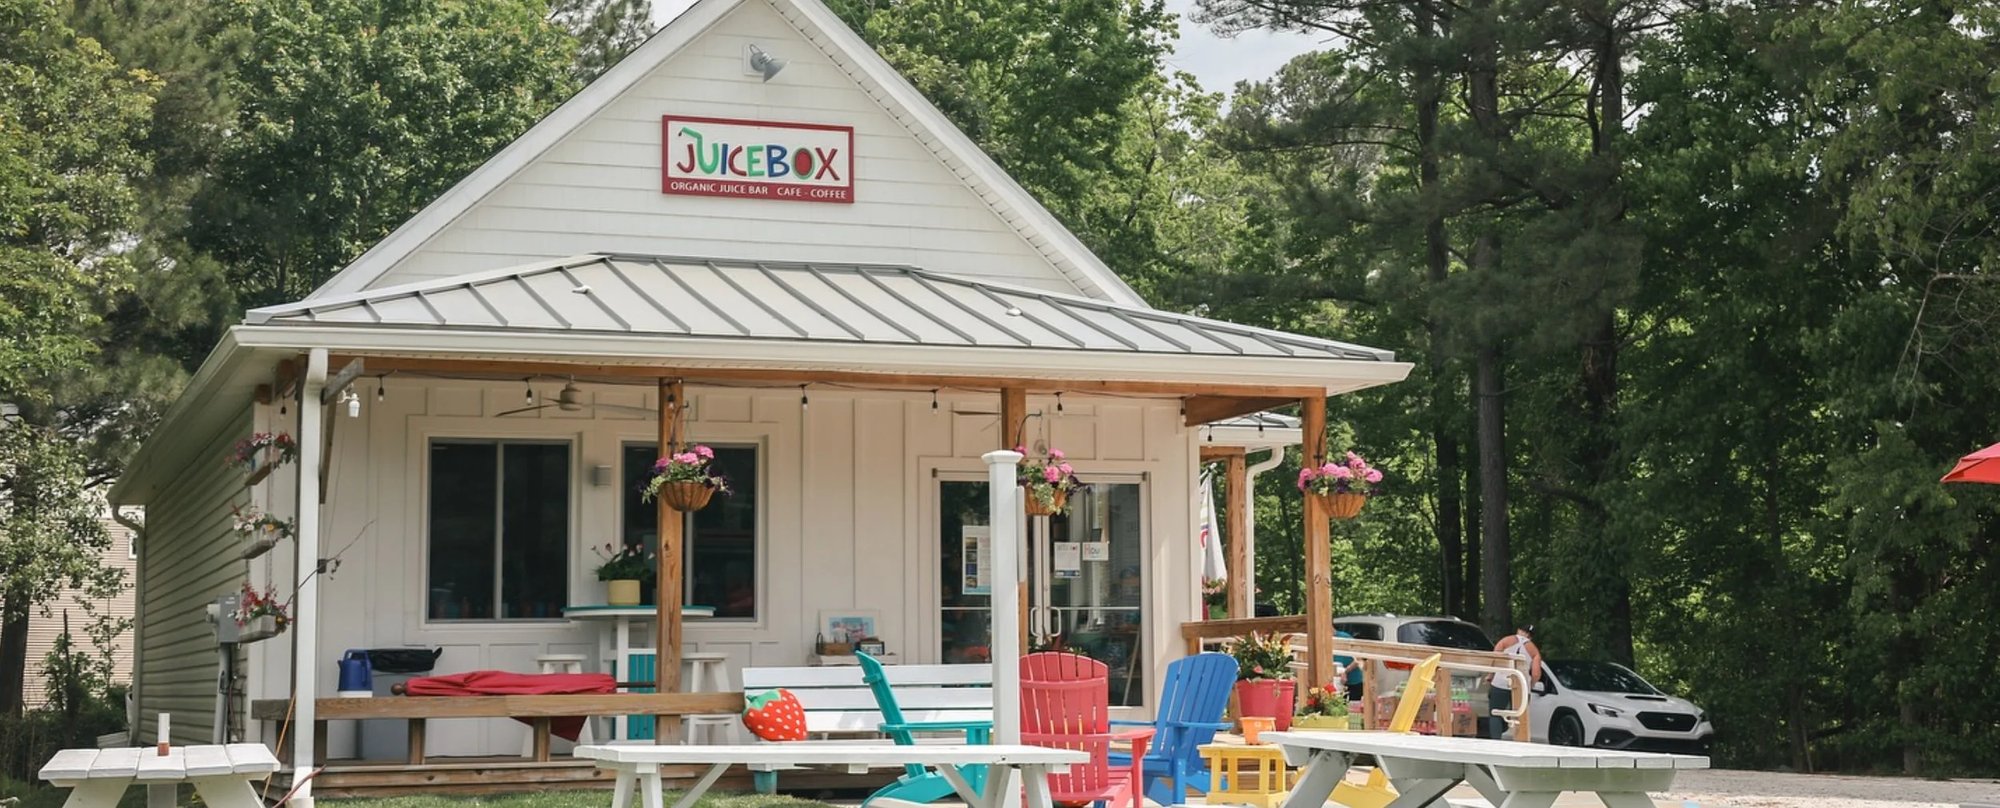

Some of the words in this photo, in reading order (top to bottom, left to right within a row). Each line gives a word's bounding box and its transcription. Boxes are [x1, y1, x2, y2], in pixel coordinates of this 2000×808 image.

[677, 127, 840, 181] JUICEBOX
[671, 181, 716, 193] ORGANIC
[719, 184, 746, 194] JUICE
[748, 186, 768, 195] BAR
[777, 187, 802, 197] CAFE
[810, 189, 846, 199] COFFEE
